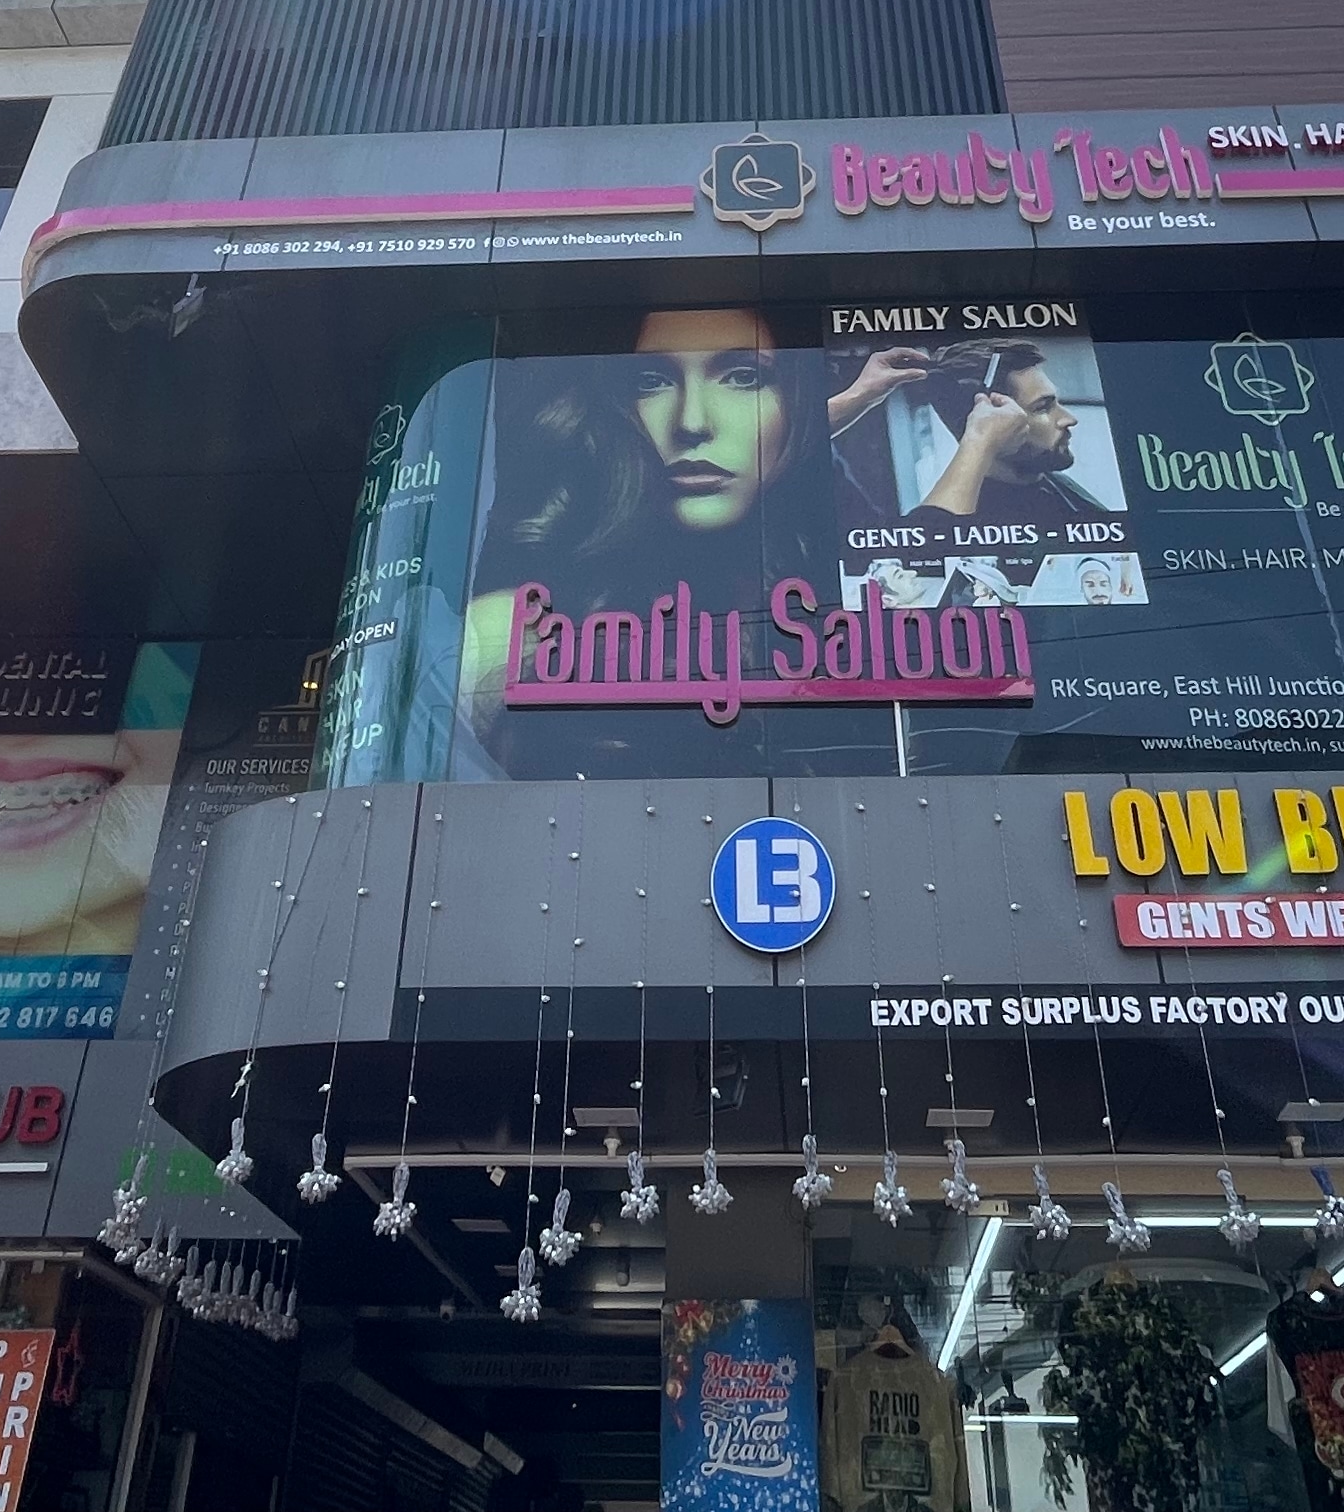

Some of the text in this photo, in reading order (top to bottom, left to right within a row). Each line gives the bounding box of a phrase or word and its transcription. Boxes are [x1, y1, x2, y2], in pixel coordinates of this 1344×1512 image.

[832, 125, 1214, 224] Beauty Tech
[1068, 211, 1217, 235] Be your best.
[212, 242, 240, 256] +91
[242, 242, 280, 255] 8086
[282, 241, 310, 254] 302
[347, 239, 374, 253] +91
[377, 239, 415, 252] 7510
[417, 238, 446, 251] 929
[447, 237, 476, 250] 570
[832, 302, 1078, 334] FAMILY SALON
[1137, 432, 1308, 509] Beauty
[1316, 500, 1342, 517] Be
[848, 526, 926, 549] GENTS
[953, 524, 1039, 546] LADIES
[1065, 522, 1126, 543] KIDS
[375, 556, 423, 581] KIDS
[354, 621, 395, 644] OPEN
[508, 576, 1032, 725] Family Saloon
[1051, 678, 1081, 698] RK
[1084, 676, 1169, 700] Square,
[1174, 675, 1218, 696] East
[1226, 674, 1262, 696] Hill
[1189, 707, 1229, 728] PH:
[352, 723, 383, 750] UP
[207, 758, 310, 775] OUR SERVICES
[1063, 788, 1249, 877] LOW
[1137, 898, 1276, 940] GENTS
[27, 972, 52, 988] TO
[71, 971, 102, 988] PM
[16, 1006, 60, 1029] 817
[64, 1006, 114, 1029] 646
[870, 997, 993, 1027] EXPORT
[1002, 996, 1142, 1026] SURPLUS
[1150, 995, 1289, 1025] FACTORY
[702, 1351, 777, 1386] Merry
[701, 1377, 791, 1401] Christmas
[869, 1390, 920, 1417] RADIO
[732, 1407, 788, 1442] New
